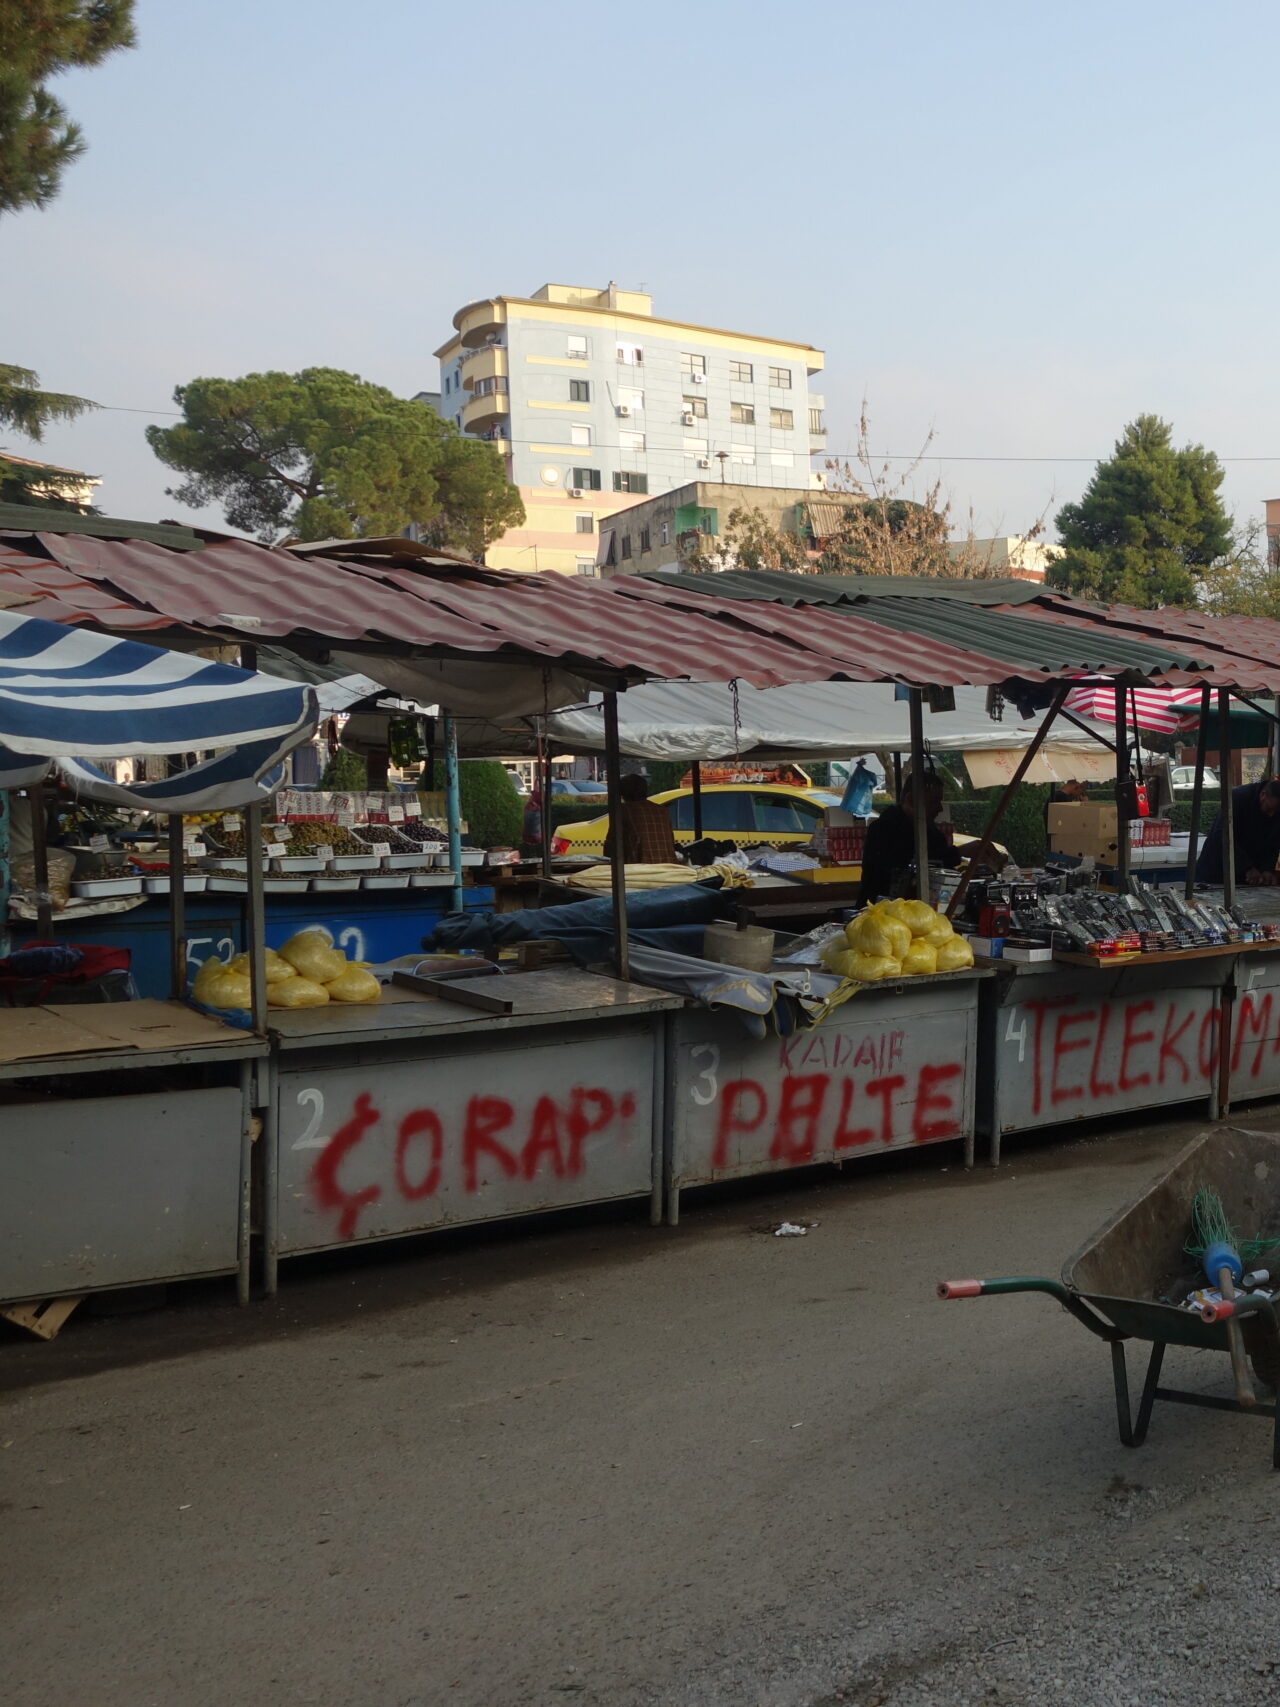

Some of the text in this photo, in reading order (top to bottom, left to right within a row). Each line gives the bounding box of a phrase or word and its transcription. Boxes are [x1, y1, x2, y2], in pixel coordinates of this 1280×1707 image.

[1005, 1007, 1027, 1063] 4
[690, 1043, 720, 1105] 3
[291, 1088, 331, 1150] 2
